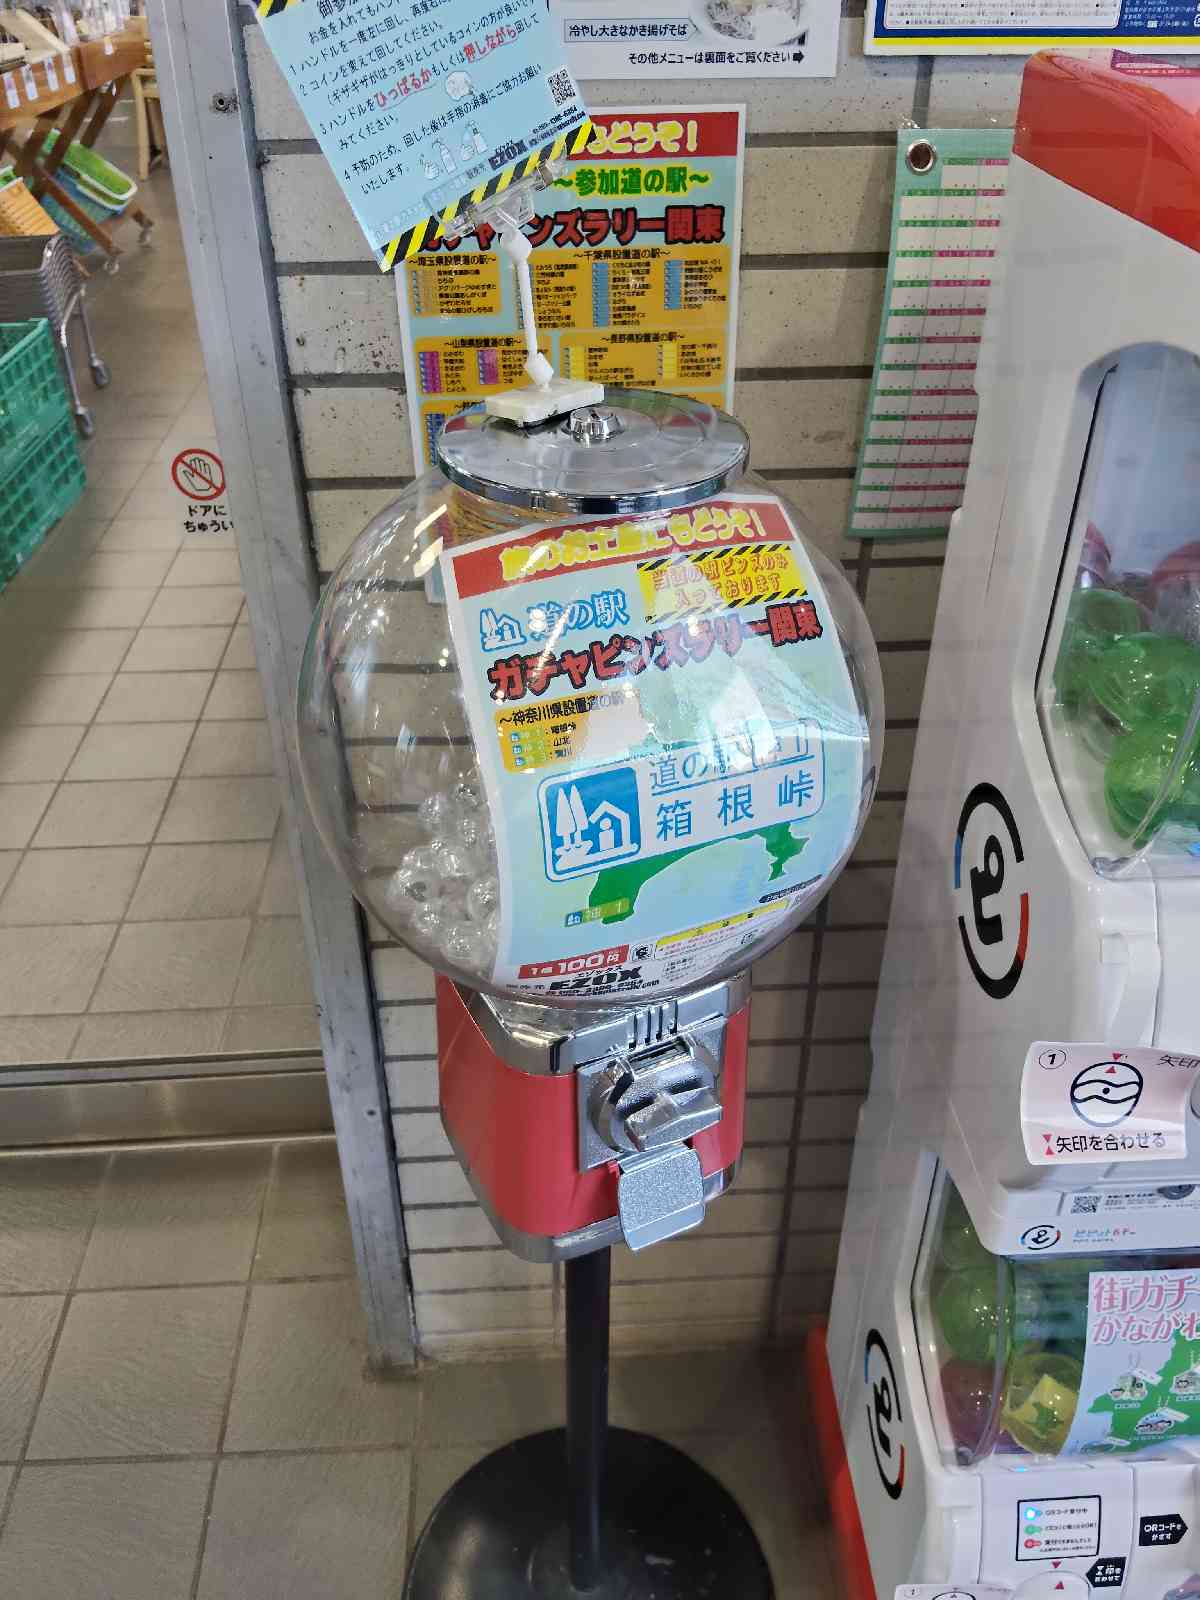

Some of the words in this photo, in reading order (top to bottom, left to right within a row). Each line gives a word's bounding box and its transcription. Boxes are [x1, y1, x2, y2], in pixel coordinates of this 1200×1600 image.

[569, 23, 687, 38] 冷やし大きなかき揚げそば
[628, 51, 791, 65] その他メニューは裏面をご覧ください
[188, 504, 228, 517] ドアに
[183, 519, 234, 533] ちゅうい
[1056, 1132, 1166, 1153] 矢印を合わせる
